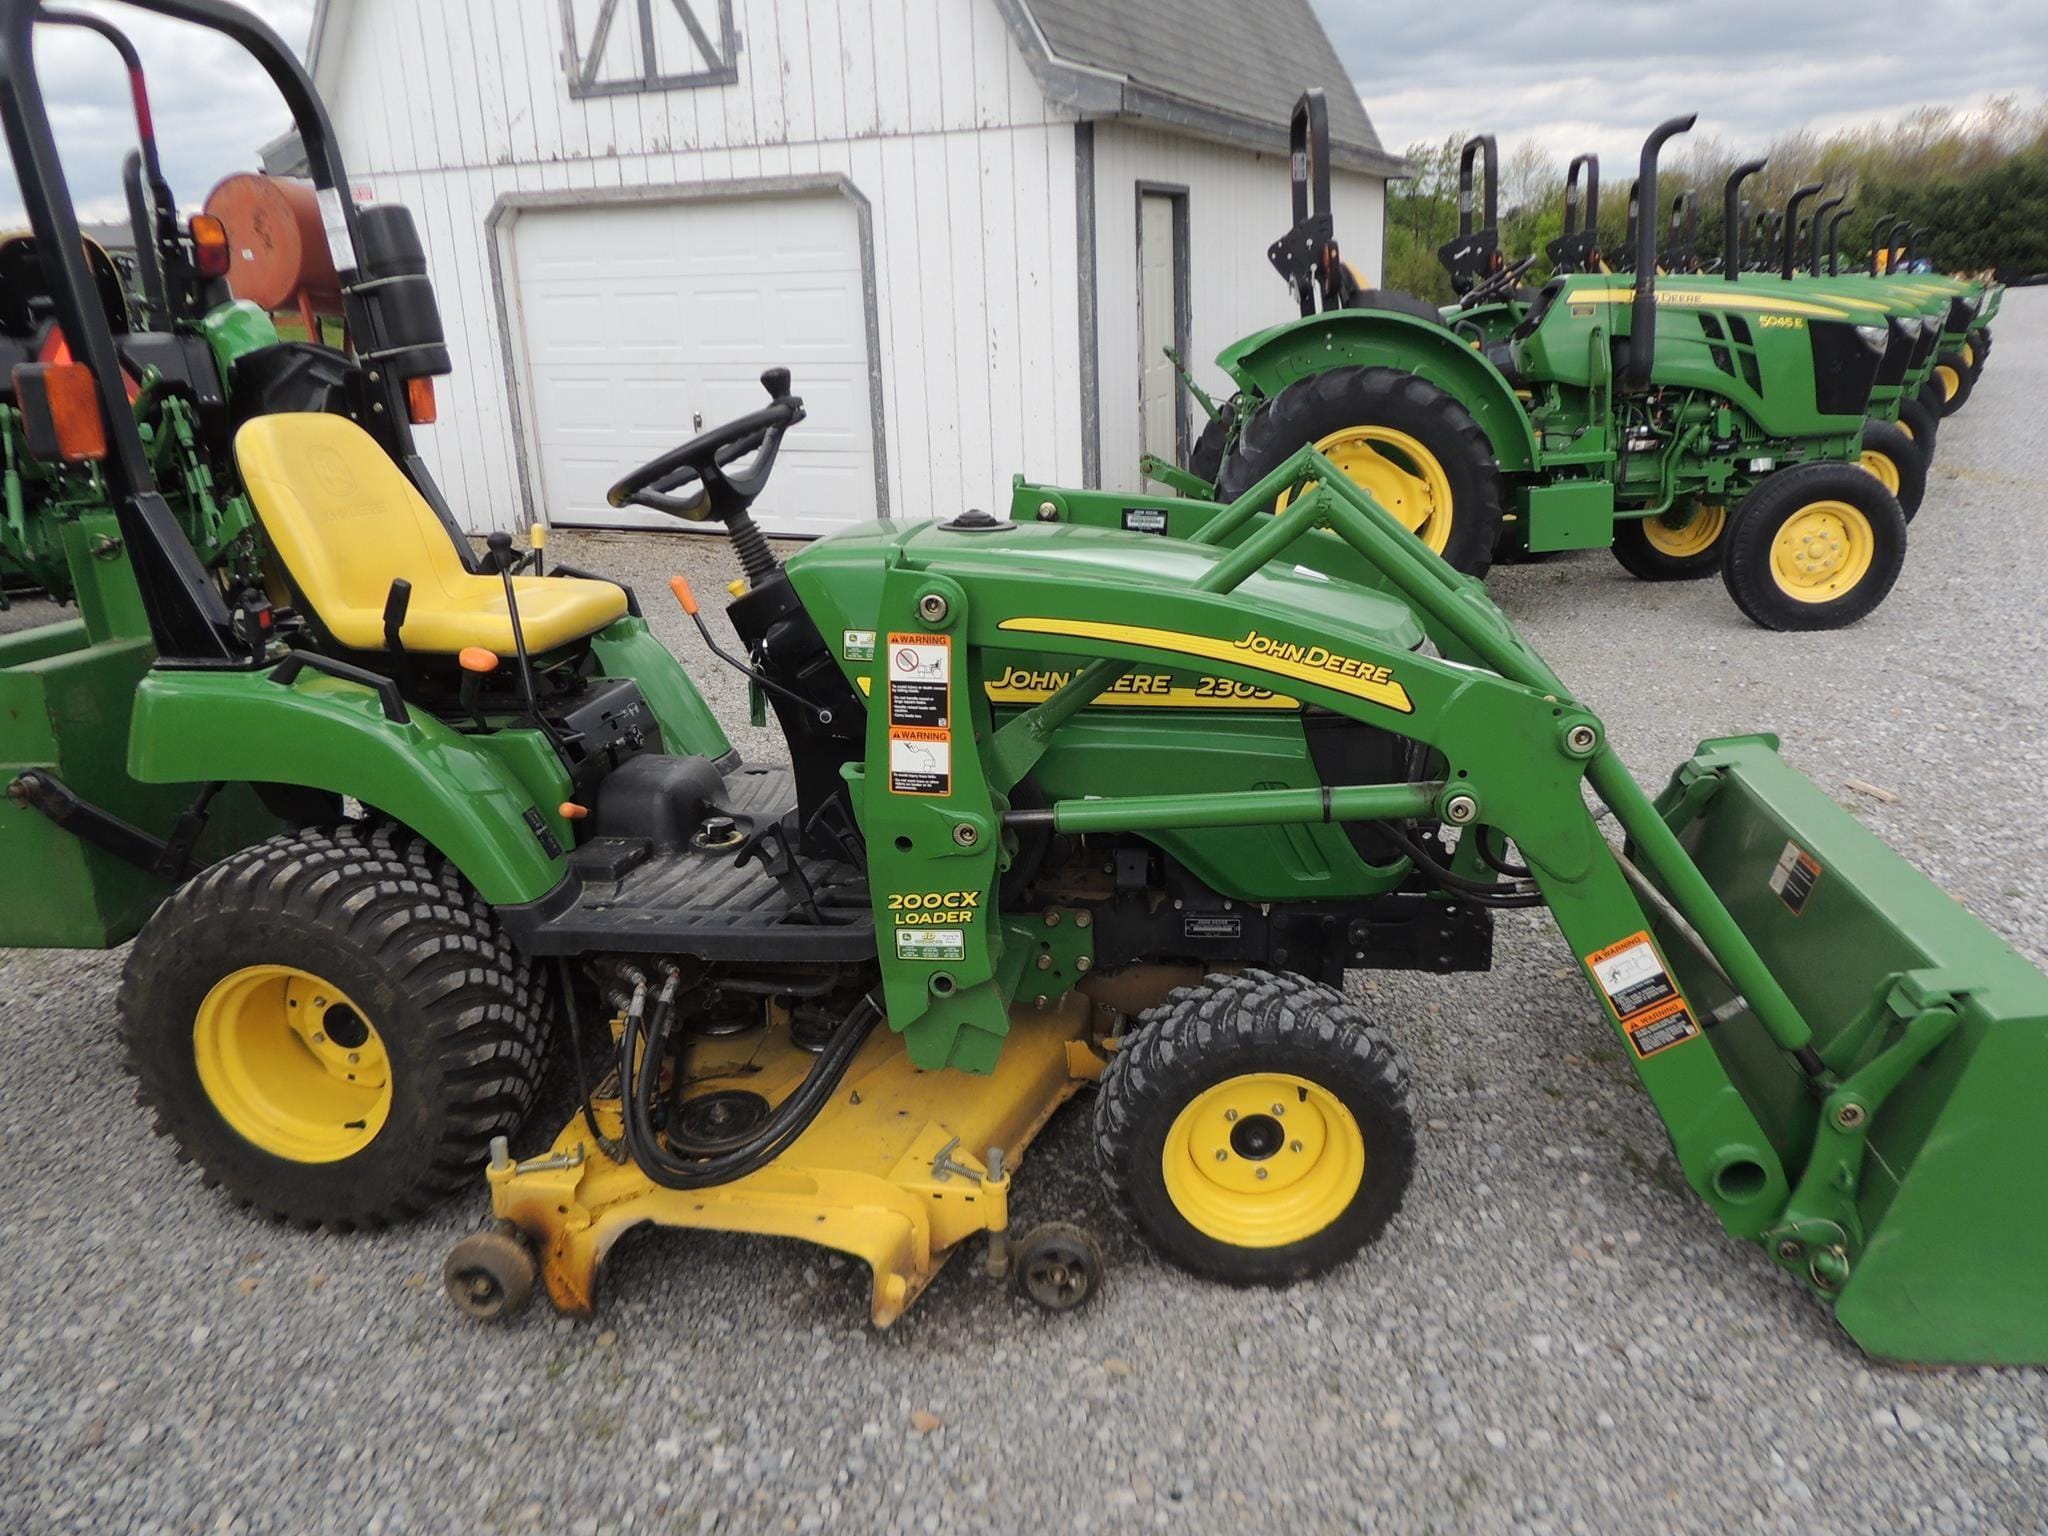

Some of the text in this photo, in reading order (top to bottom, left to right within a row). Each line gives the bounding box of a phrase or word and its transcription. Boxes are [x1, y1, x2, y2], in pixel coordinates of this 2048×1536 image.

[1661, 293, 1703, 303] DEERE
[900, 634, 947, 645] WARNING
[1234, 630, 1393, 684] JOHN DEERE
[991, 666, 1070, 689] JOHN
[1075, 669, 1172, 693] ERE
[901, 730, 947, 741] WARNING
[887, 891, 981, 909] 200CX
[895, 910, 973, 925] LOADER
[1602, 936, 1642, 958] WARNING
[1640, 1003, 1680, 1025] WARNING
